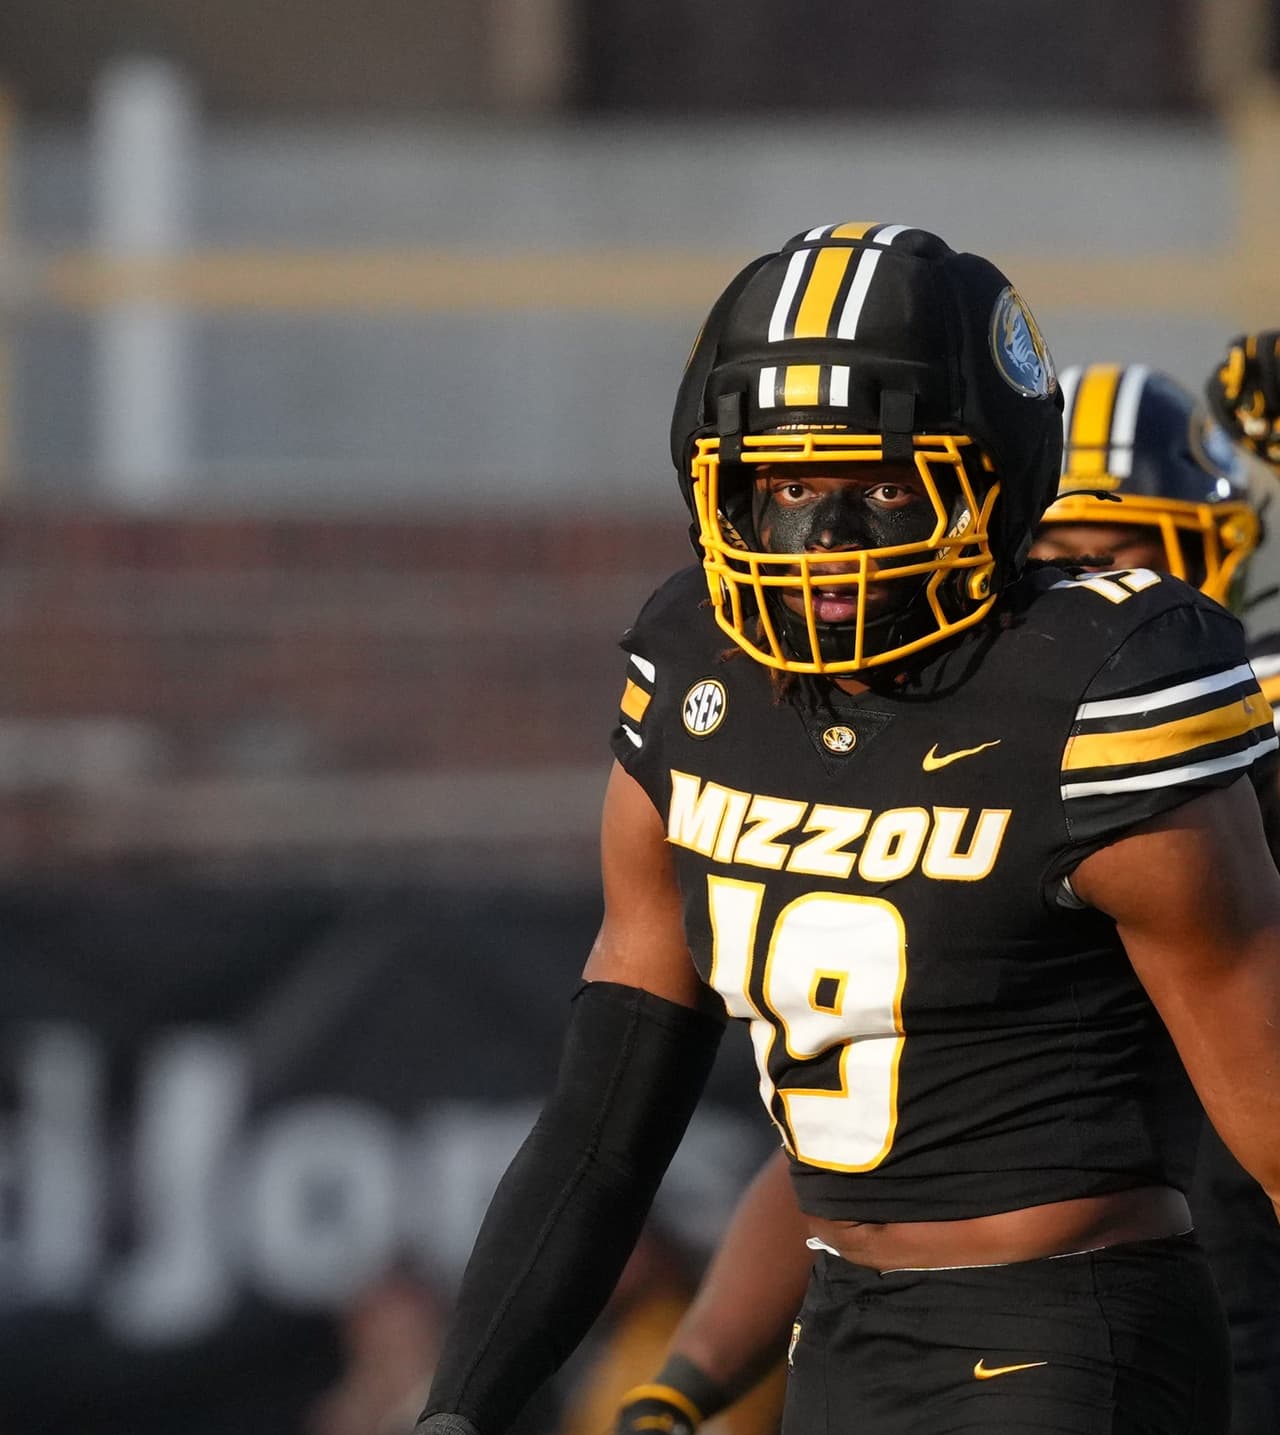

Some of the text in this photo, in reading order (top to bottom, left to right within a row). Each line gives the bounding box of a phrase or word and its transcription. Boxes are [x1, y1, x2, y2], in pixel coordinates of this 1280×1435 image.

[685, 682, 723, 732] SEC
[664, 769, 1013, 883] MIZZOU
[708, 875, 907, 1173] 19
